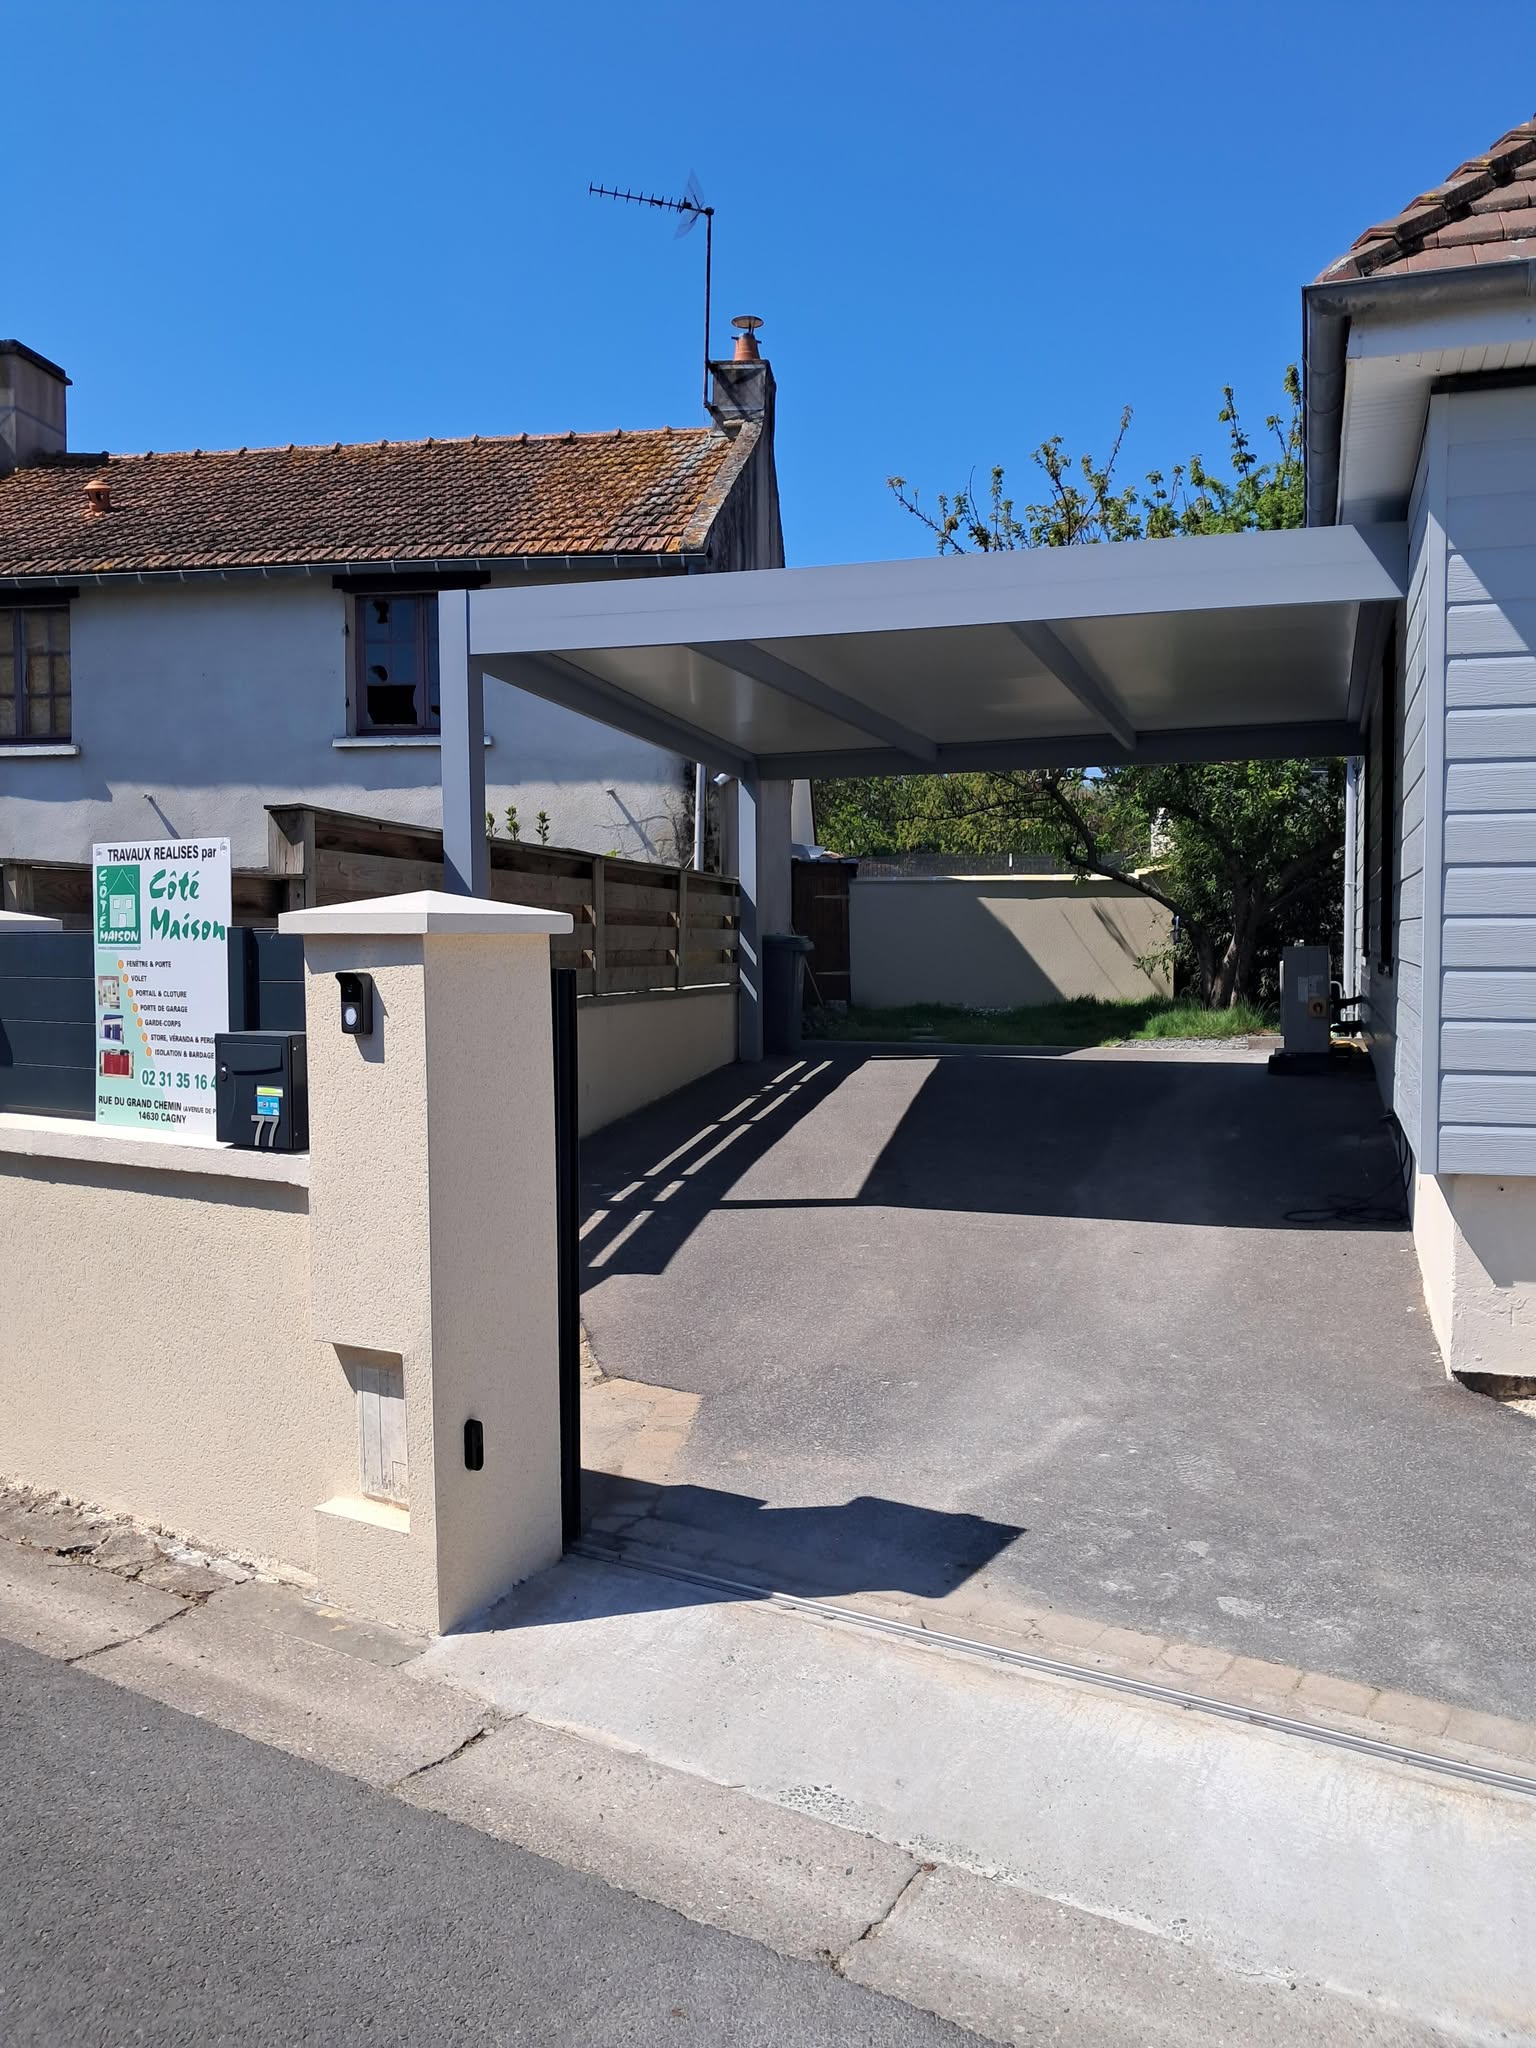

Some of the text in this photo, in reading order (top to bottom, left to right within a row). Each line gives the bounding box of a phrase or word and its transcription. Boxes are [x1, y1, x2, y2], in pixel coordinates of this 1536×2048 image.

[107, 845, 217, 862] TRAVAUX REALISES par
[149, 868, 200, 902] Côté
[150, 906, 226, 941] Maison
[99, 930, 139, 943] MAISON
[126, 960, 148, 968] FENÊTRE
[135, 989, 157, 997] PORTAIL
[163, 990, 187, 998] CLOTURE
[140, 1004, 156, 1012] PORTE
[166, 1005, 188, 1013] GARAGE
[145, 1019, 181, 1027] GARDE-CORPS
[150, 1034, 168, 1042] STORE,
[169, 1034, 194, 1043] VÉRANDA
[200, 1036, 216, 1044] PERG
[155, 1047, 182, 1057] ISOLATION
[189, 1050, 214, 1059] BARDAGE
[141, 1070, 156, 1086] 02
[159, 1071, 172, 1087] 31
[176, 1072, 190, 1089] 35
[194, 1074, 208, 1090] 16
[98, 1095, 112, 1105] RUE
[114, 1096, 125, 1106] DU
[126, 1097, 152, 1109] GRAND
[154, 1100, 182, 1111] CHEMIN
[138, 1111, 187, 1124] 14630 CAGNY
[250, 1114, 280, 1147] 77
